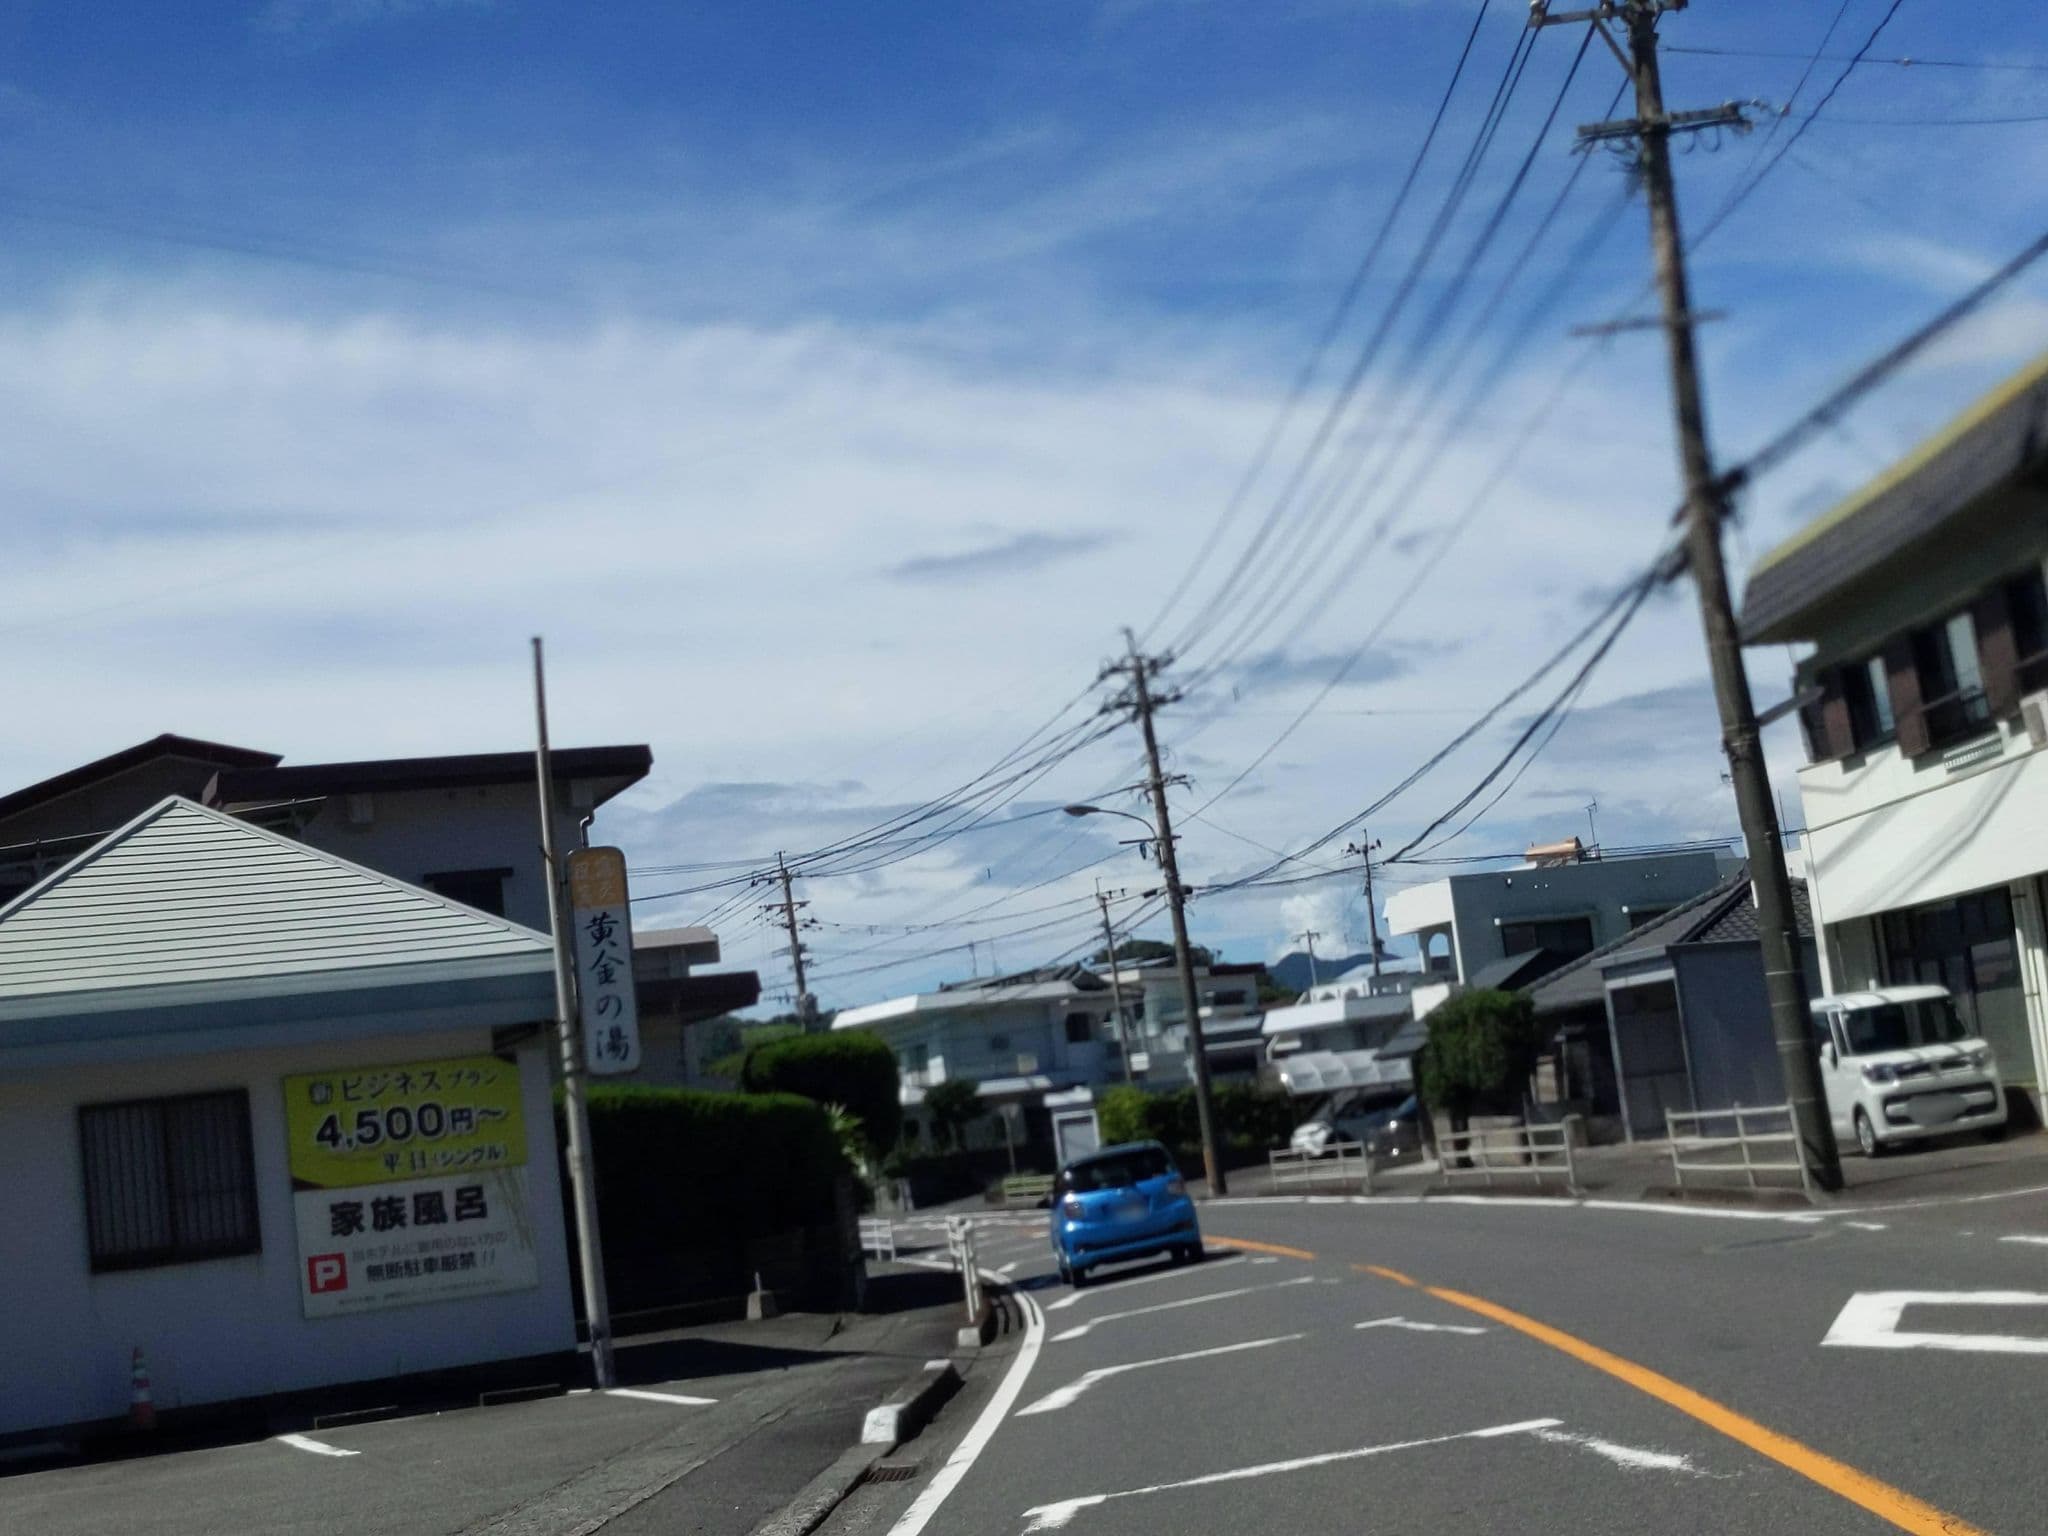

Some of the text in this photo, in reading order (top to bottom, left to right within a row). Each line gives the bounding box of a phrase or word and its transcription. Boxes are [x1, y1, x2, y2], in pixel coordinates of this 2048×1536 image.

[584, 911, 630, 1062] 黄金の湯
[330, 1184, 488, 1237] 家族風呂
